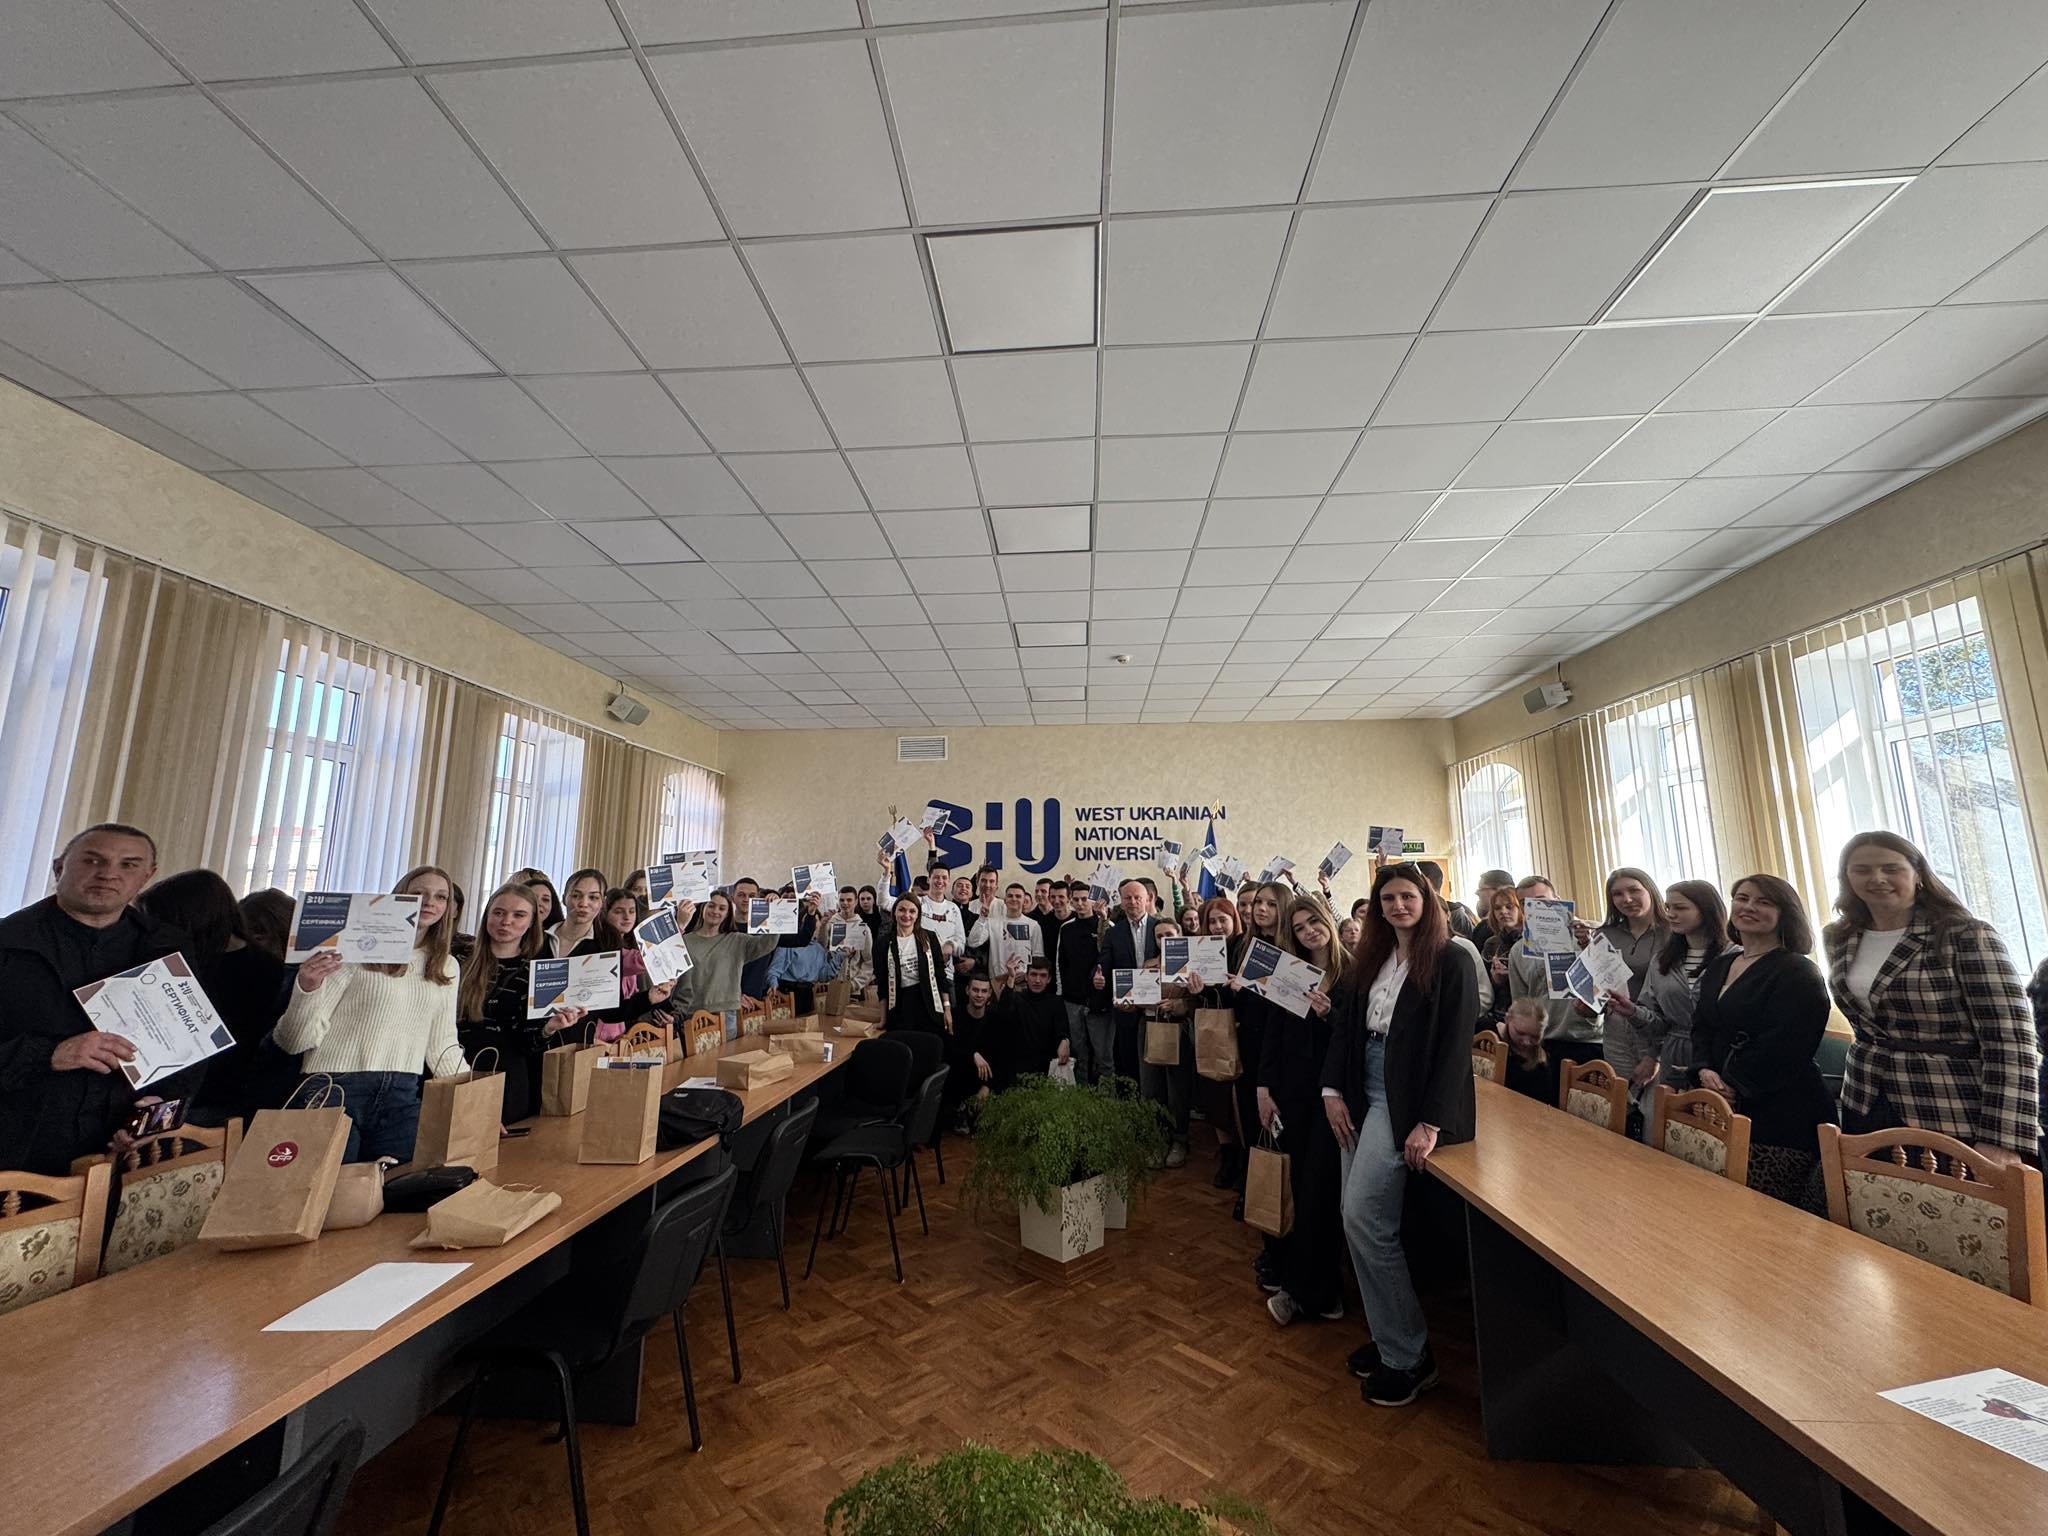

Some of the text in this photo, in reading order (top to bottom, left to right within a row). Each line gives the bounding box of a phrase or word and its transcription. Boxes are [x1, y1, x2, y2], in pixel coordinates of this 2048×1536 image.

[1075, 806, 1226, 821] WEST UKRAINIAN
[1075, 827, 1164, 841] NATIONAL
[1075, 847, 1161, 861] UNIVERSI
[1402, 843, 1423, 851] ИХІД
[161, 982, 199, 1034] СЕРТИФІКАТ
